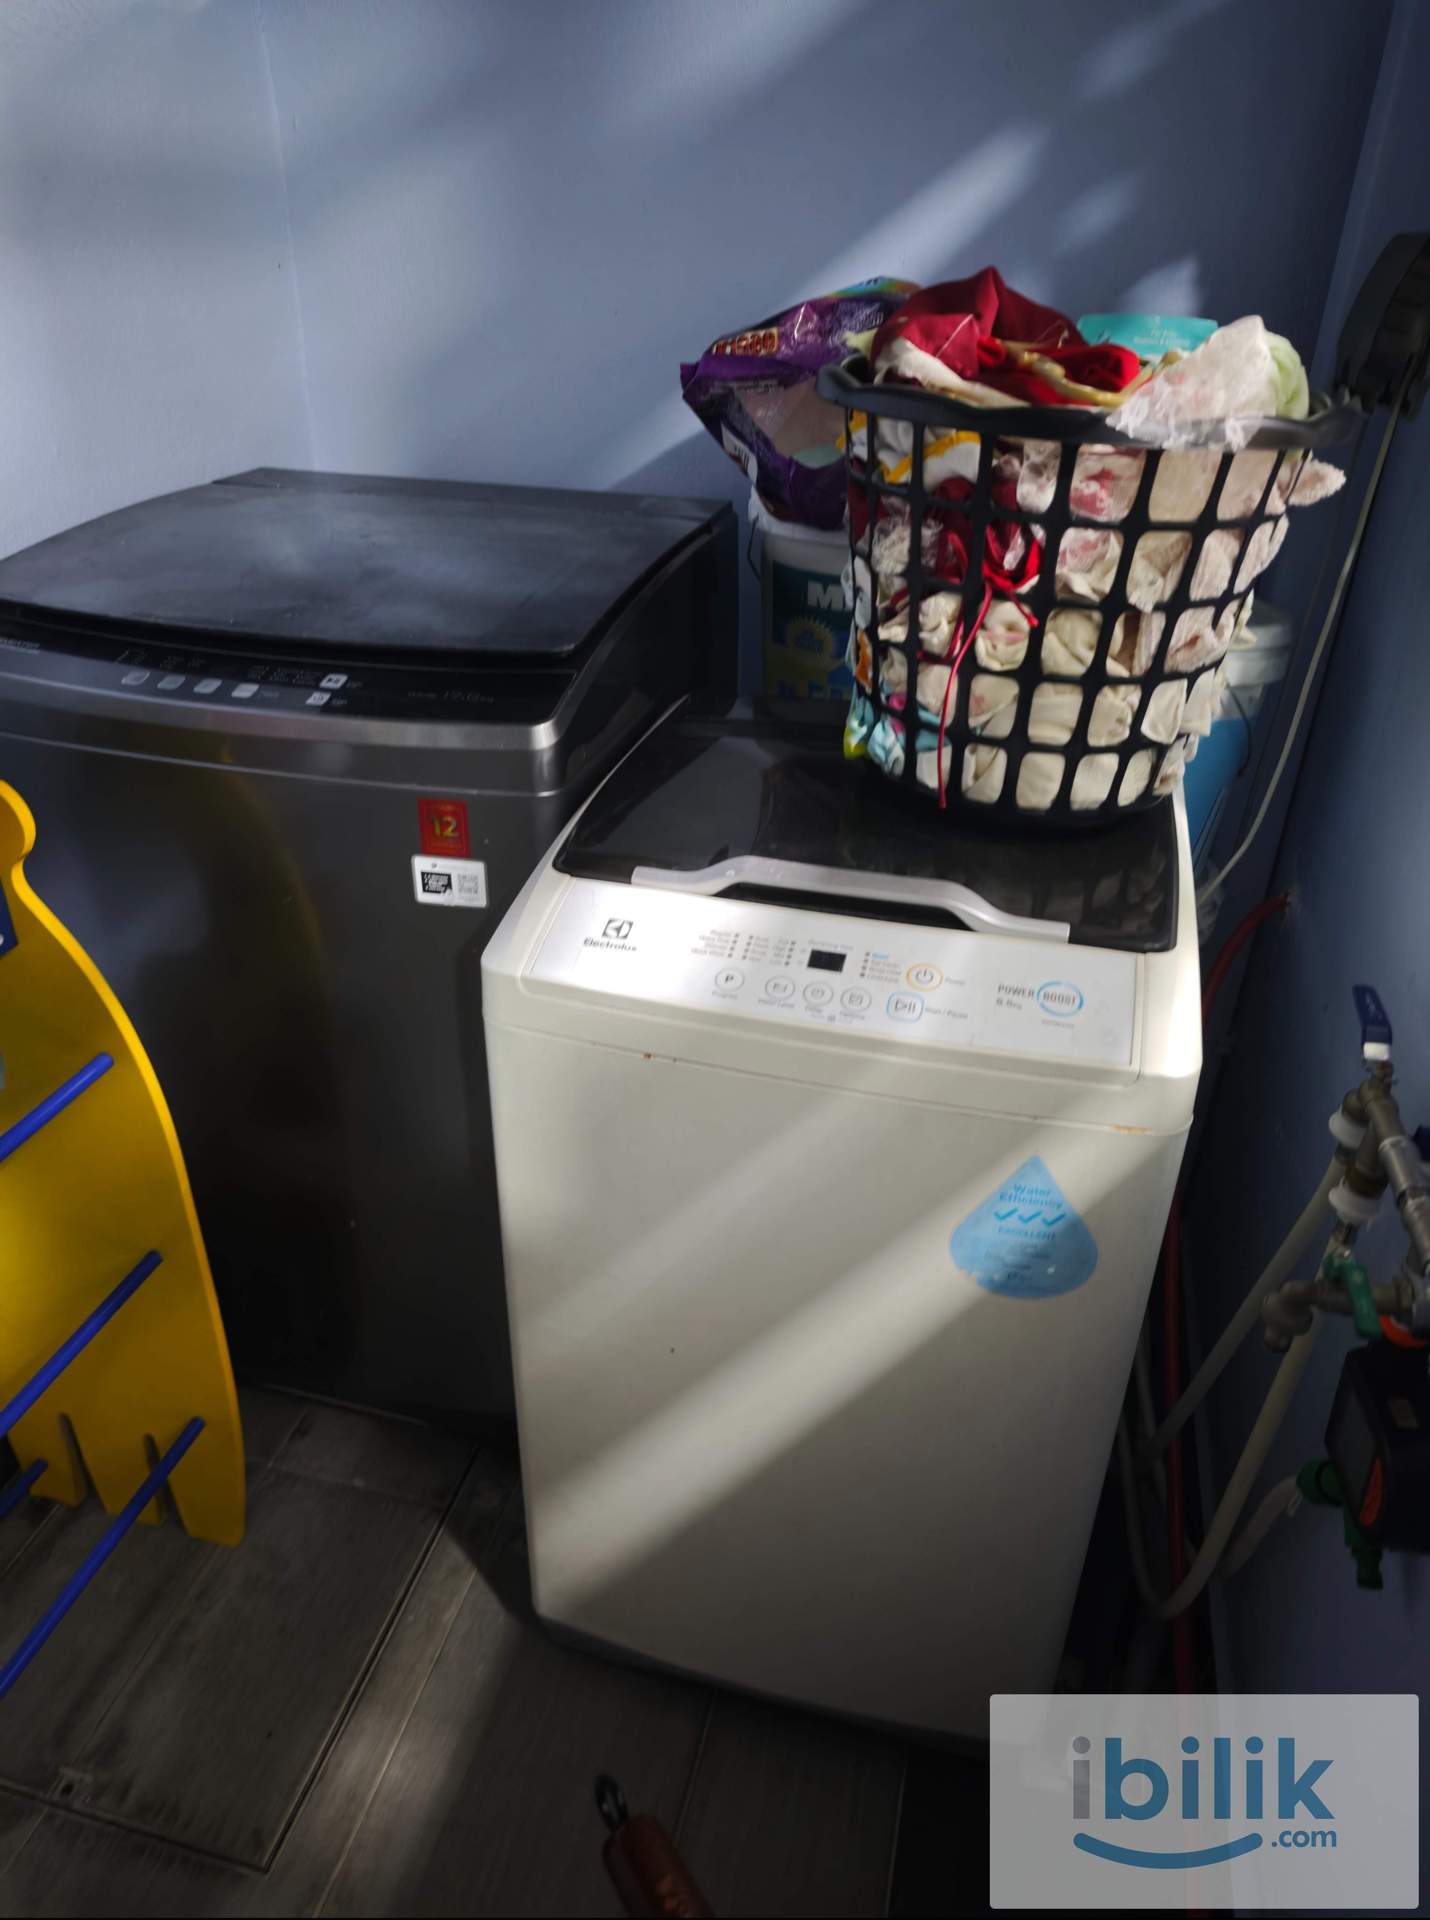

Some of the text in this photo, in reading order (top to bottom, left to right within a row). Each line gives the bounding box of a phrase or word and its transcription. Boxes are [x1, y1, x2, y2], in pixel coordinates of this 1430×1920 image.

[583, 937, 637, 952] Electrolux
[997, 984, 1076, 1006] POWER BOOST
[1014, 1184, 1051, 1197] Water
[999, 1192, 1063, 1209] Efficiency
